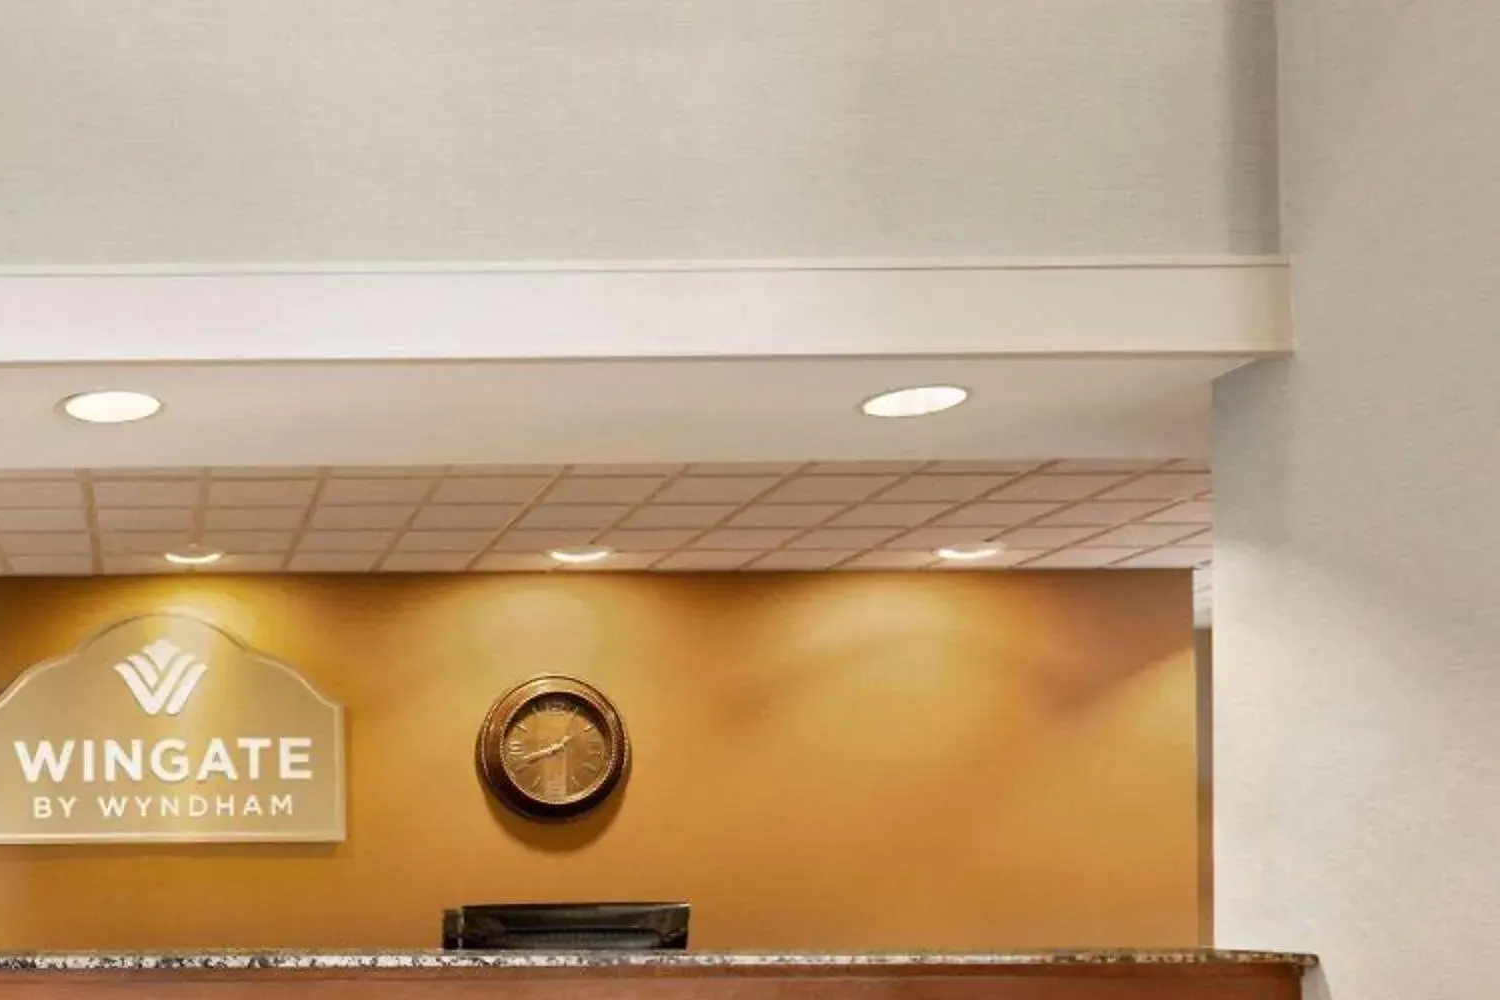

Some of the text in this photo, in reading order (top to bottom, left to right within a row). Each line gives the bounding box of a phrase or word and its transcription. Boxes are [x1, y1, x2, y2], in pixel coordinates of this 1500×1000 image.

[14, 737, 312, 783] WINGATE
[33, 795, 293, 819] BY WYNDHAM
